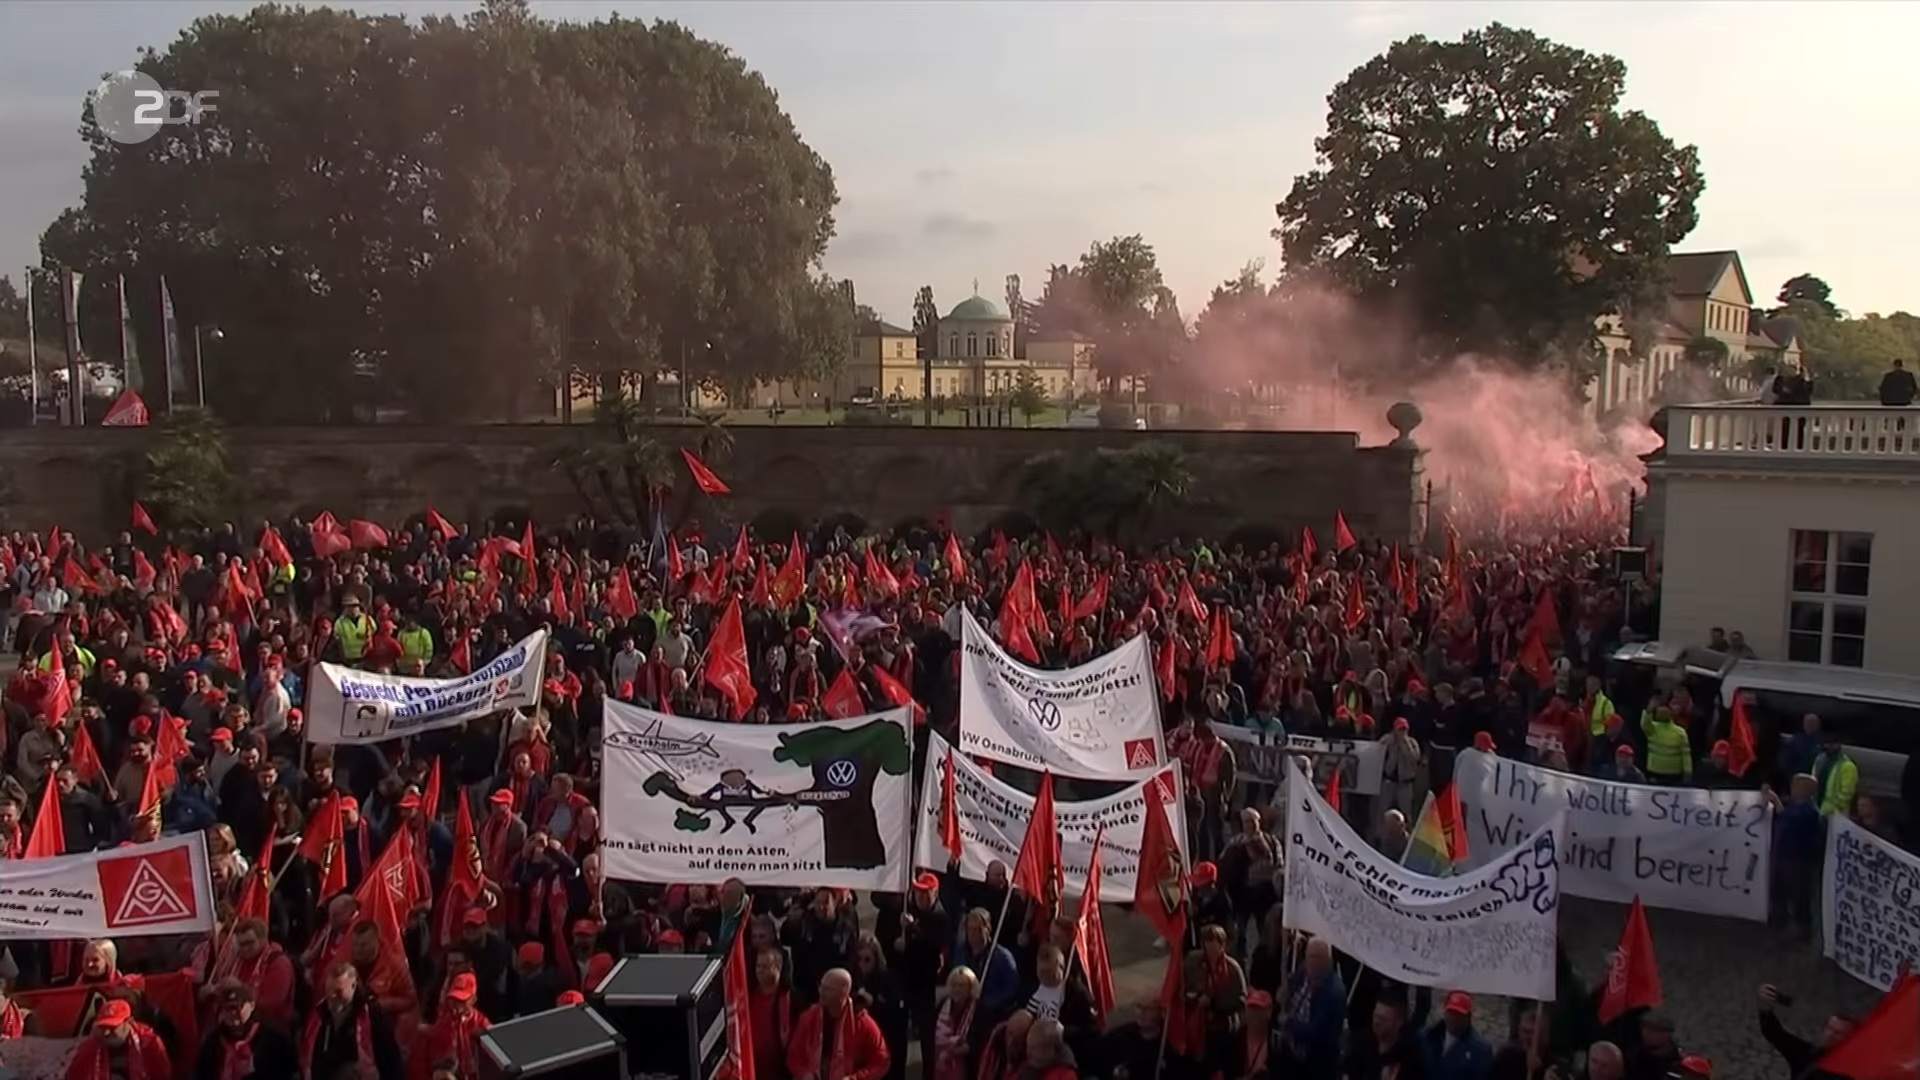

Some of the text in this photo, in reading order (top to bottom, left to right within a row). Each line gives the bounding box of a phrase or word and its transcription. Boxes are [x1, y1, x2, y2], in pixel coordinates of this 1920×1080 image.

[1035, 686, 1082, 701] Kampf
[1101, 673, 1141, 695] jetzt!
[962, 731, 981, 744] VW
[1091, 797, 1144, 821] gelten
[1494, 763, 1767, 837] Ihr wollt Streit?
[658, 841, 693, 855] nicht
[697, 845, 714, 855] an
[717, 844, 743, 856] den
[1481, 808, 1531, 846] Wi
[1636, 837, 1759, 894] bereit!
[688, 857, 821, 871] auf denen man sitzt
[1344, 850, 1409, 892] Fehler
[1432, 898, 1503, 922] zeigen
